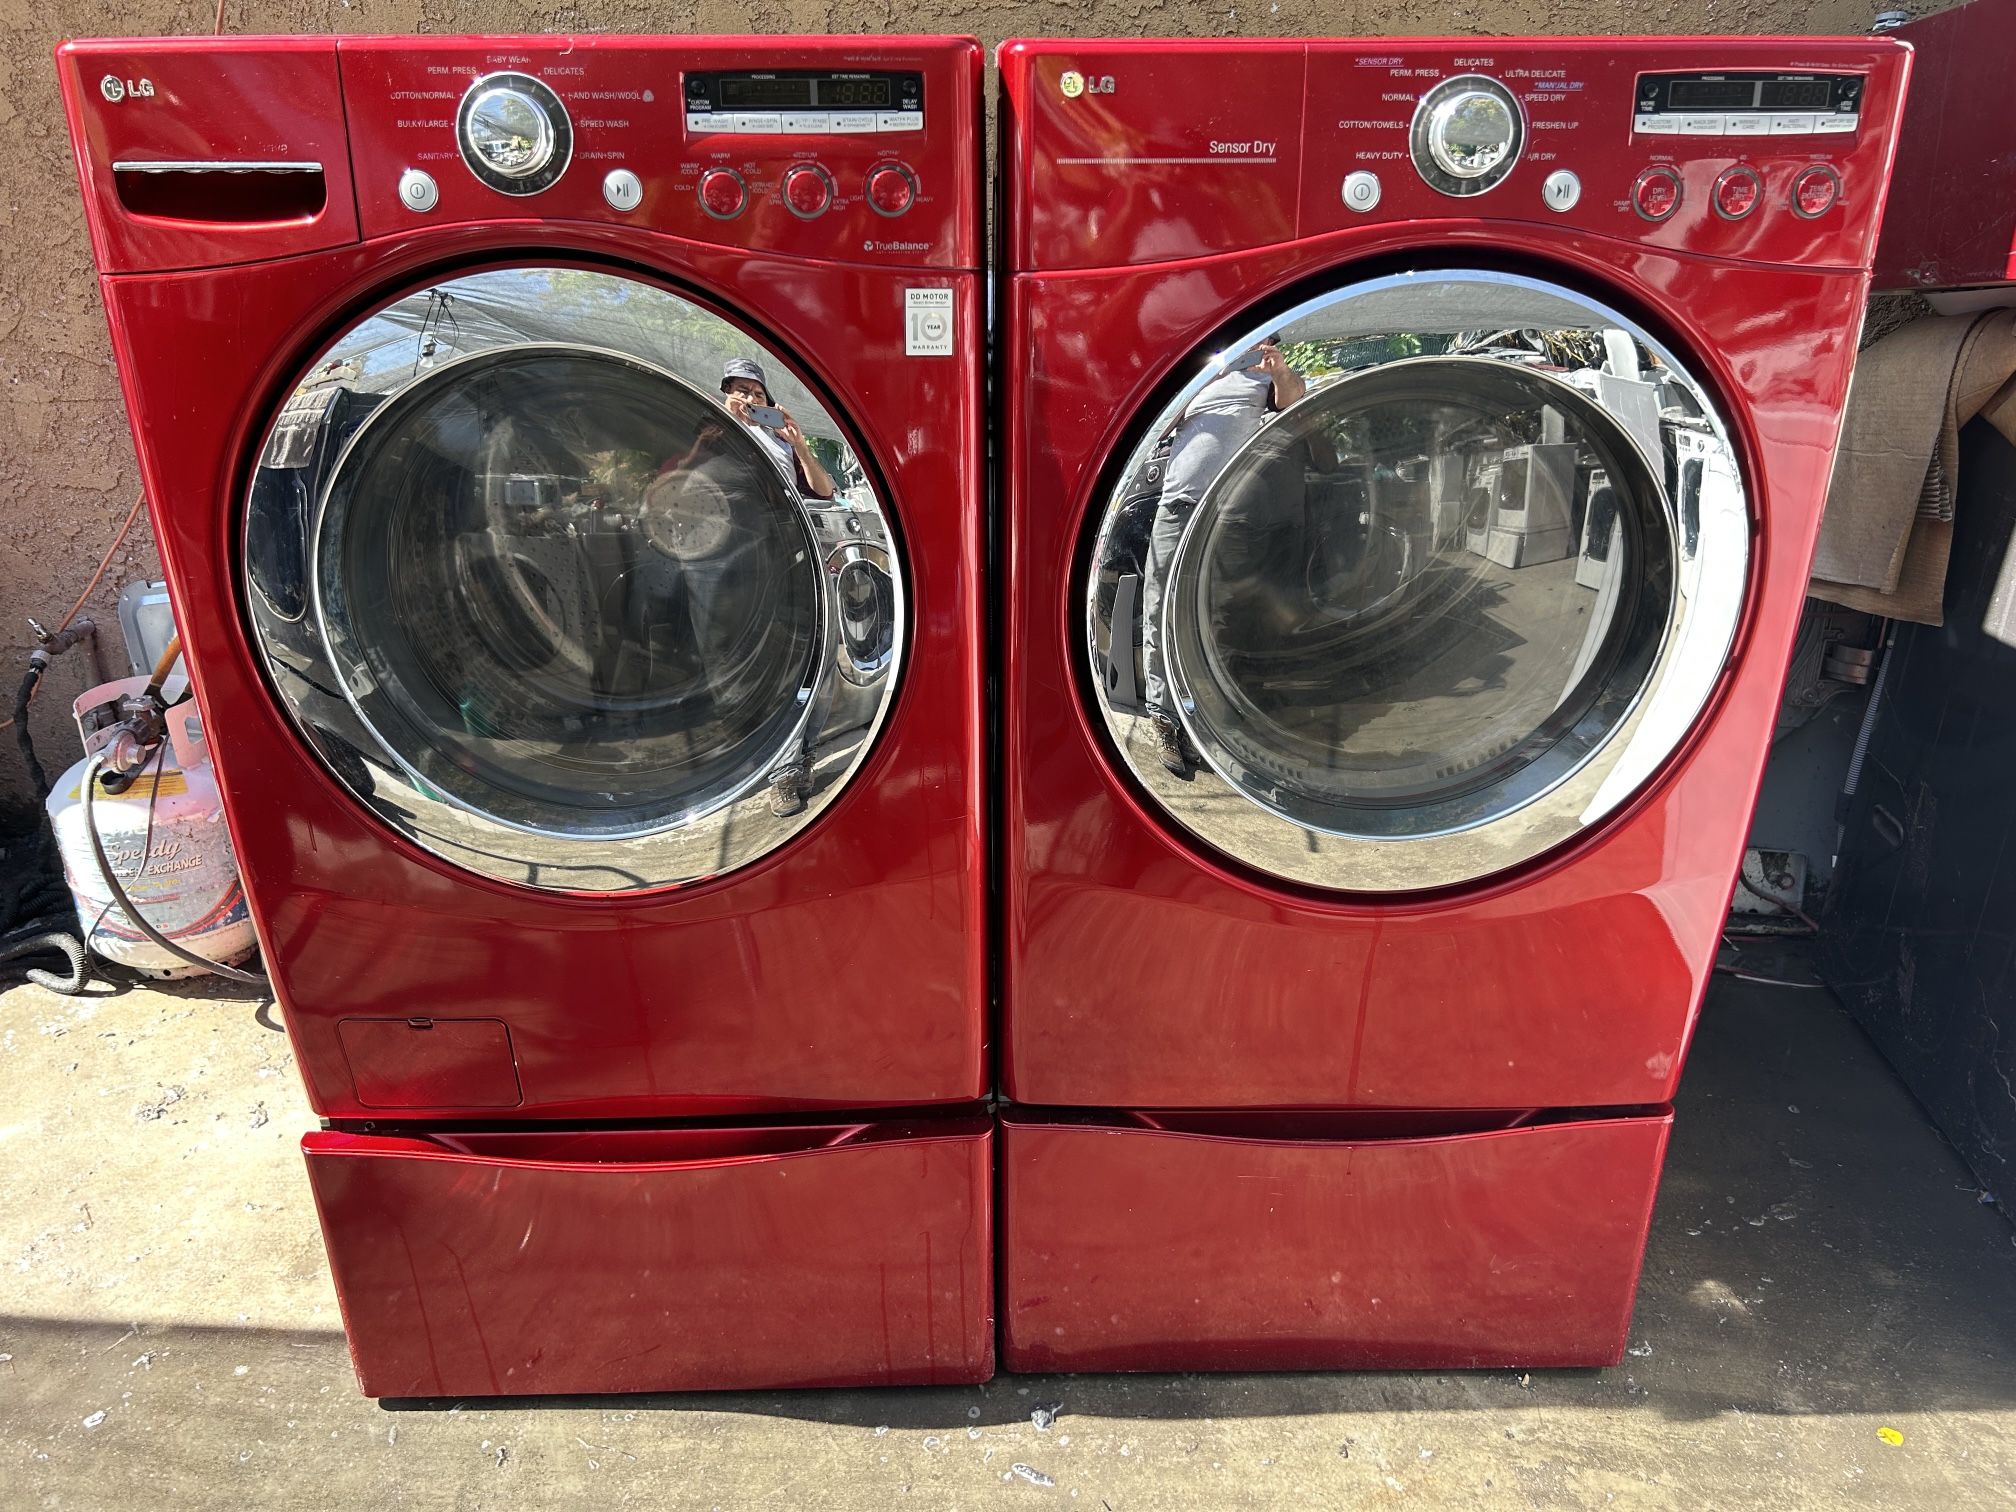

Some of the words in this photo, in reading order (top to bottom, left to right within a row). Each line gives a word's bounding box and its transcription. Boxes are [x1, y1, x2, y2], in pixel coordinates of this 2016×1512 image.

[1388, 57, 1404, 66] DRY
[1453, 58, 1495, 67] DELICATES
[427, 66, 450, 75] PERM.
[452, 66, 477, 75] PRESS
[543, 67, 585, 76] DELICATES
[1389, 69, 1414, 77] PERM.
[1414, 69, 1440, 77] PRESS
[1505, 69, 1529, 78] ULTRA
[1530, 70, 1567, 78] DELICATE
[128, 78, 154, 97] LG
[1088, 76, 1115, 94] LG
[390, 91, 456, 100] COTTON/NORMAL
[591, 91, 641, 100] WASH/WOOL
[1381, 93, 1415, 102] NORMAL
[1524, 93, 1549, 102] SPEED
[1549, 93, 1566, 102] DRY
[397, 119, 449, 128] BULKY/LARGE
[580, 119, 605, 128] SPEED
[606, 119, 630, 128] WASH
[1338, 120, 1404, 129] COTTON/TOWELS
[1531, 121, 1566, 130] FRESHEN
[1567, 121, 1579, 130] UP
[1209, 140, 1251, 154] Sensor
[1253, 140, 1277, 158] Dry
[417, 152, 454, 161] SANITARY
[579, 151, 625, 160] DRAIN+SPIN
[1355, 151, 1381, 160] HEAVY
[1381, 151, 1404, 160] DUTY
[1540, 152, 1557, 161] DRY
[911, 311, 947, 341] 10
[110, 839, 182, 866] Spedy
[147, 854, 203, 876] EXCHANGE
